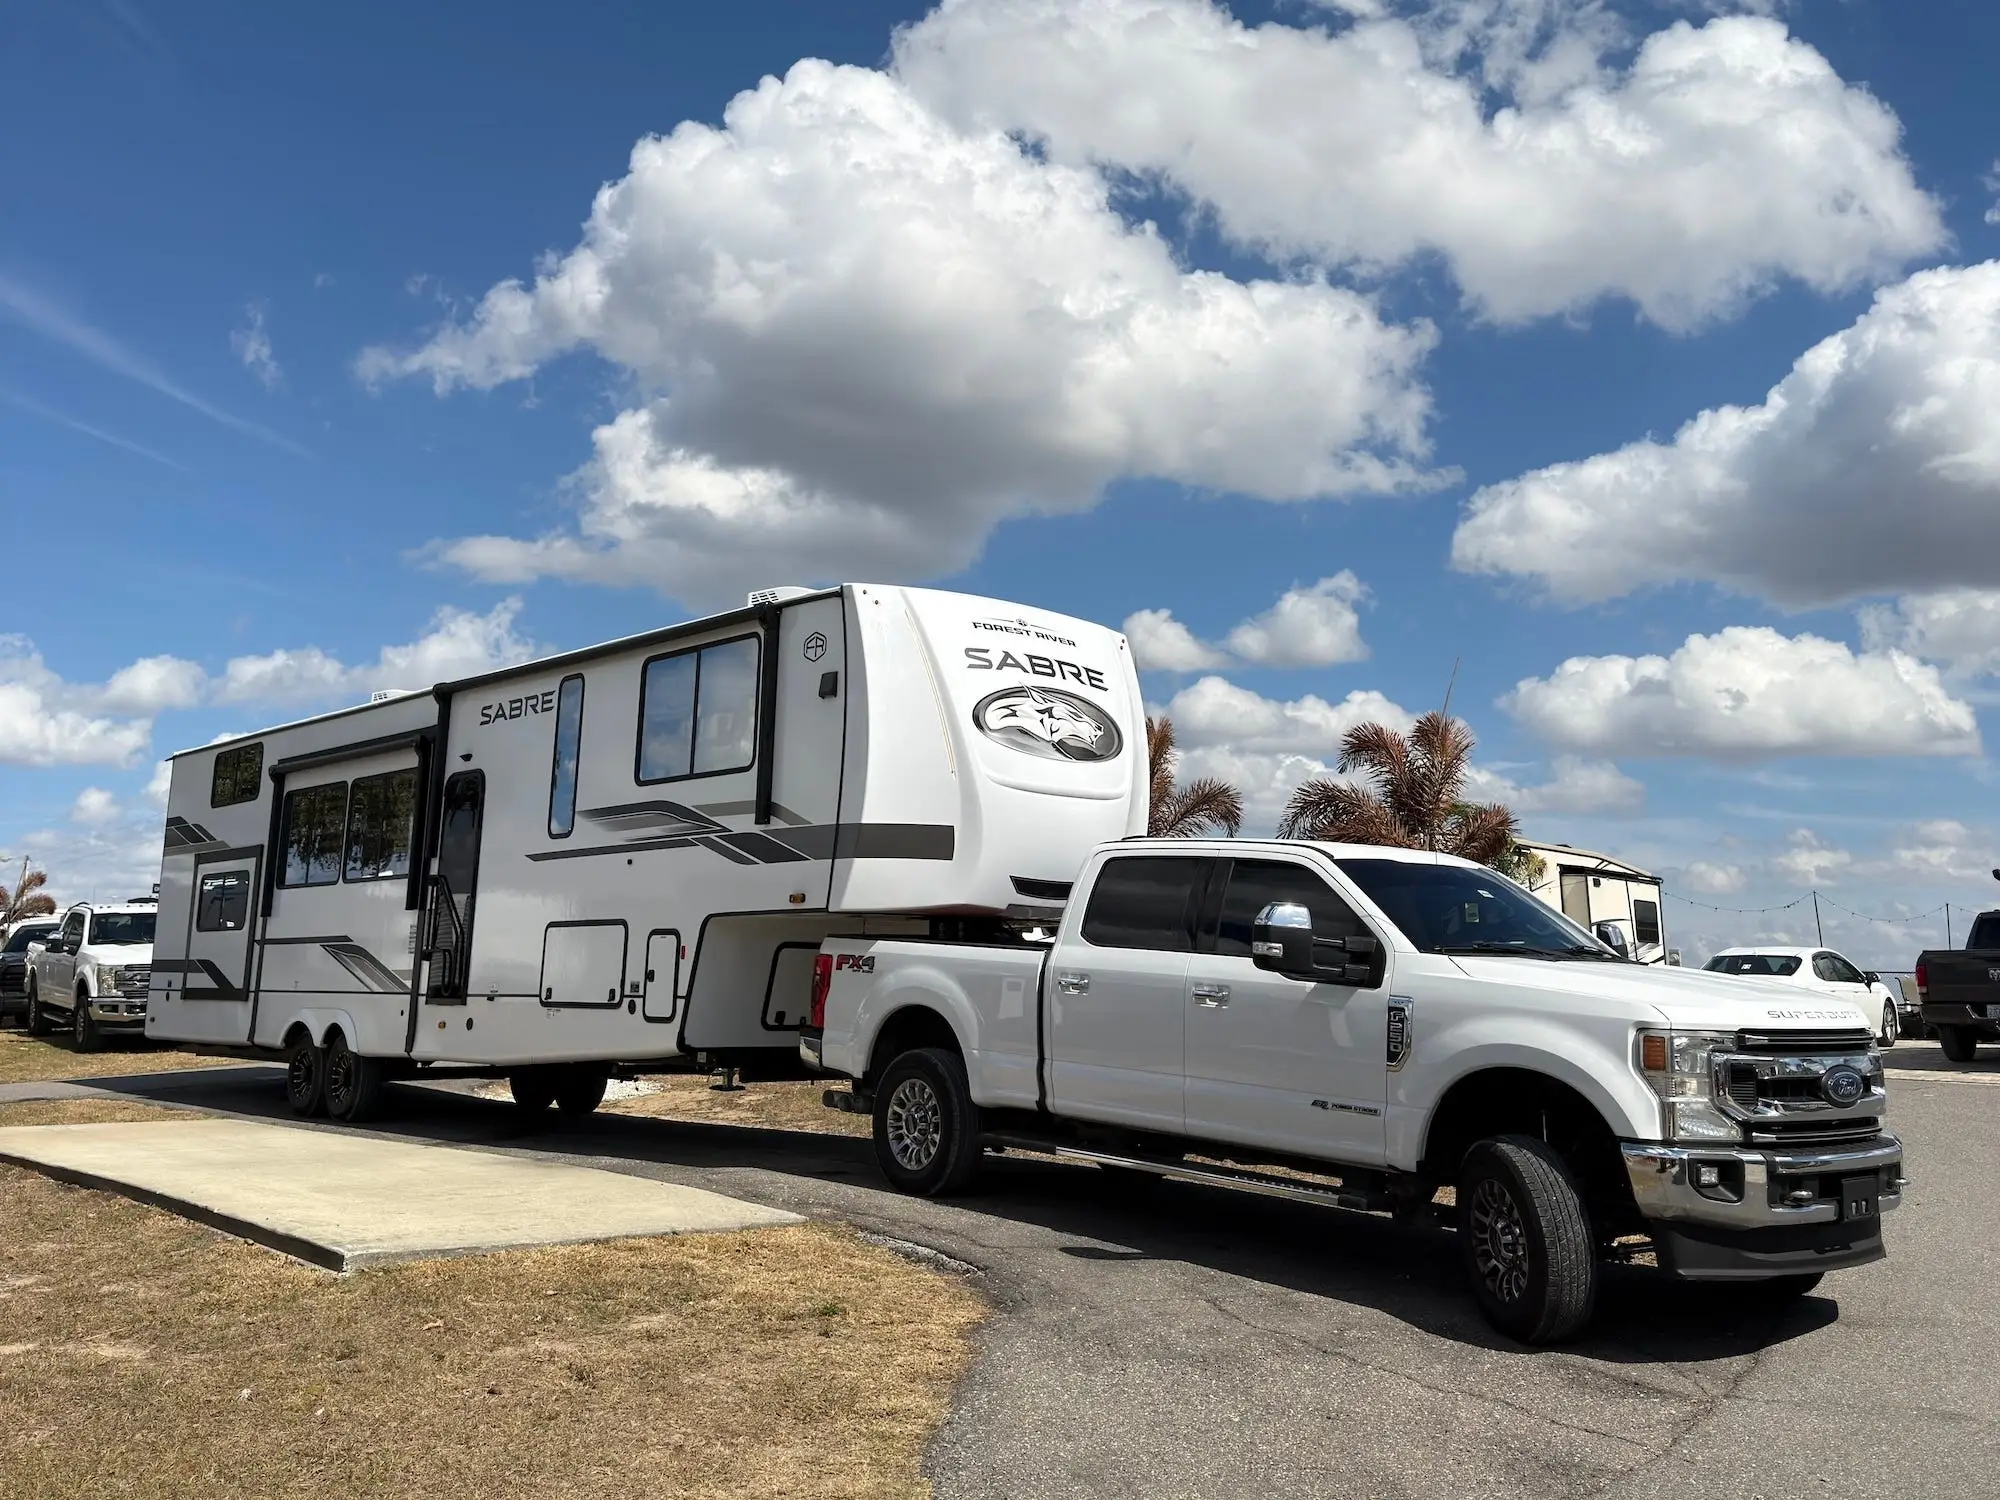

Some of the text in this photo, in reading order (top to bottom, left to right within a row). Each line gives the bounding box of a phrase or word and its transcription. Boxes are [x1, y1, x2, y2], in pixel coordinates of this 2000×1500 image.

[972, 622, 1077, 647] FOREST RIVER
[964, 648, 1108, 691] SABRE
[480, 690, 556, 726] SABRE
[836, 954, 875, 970] FX4
